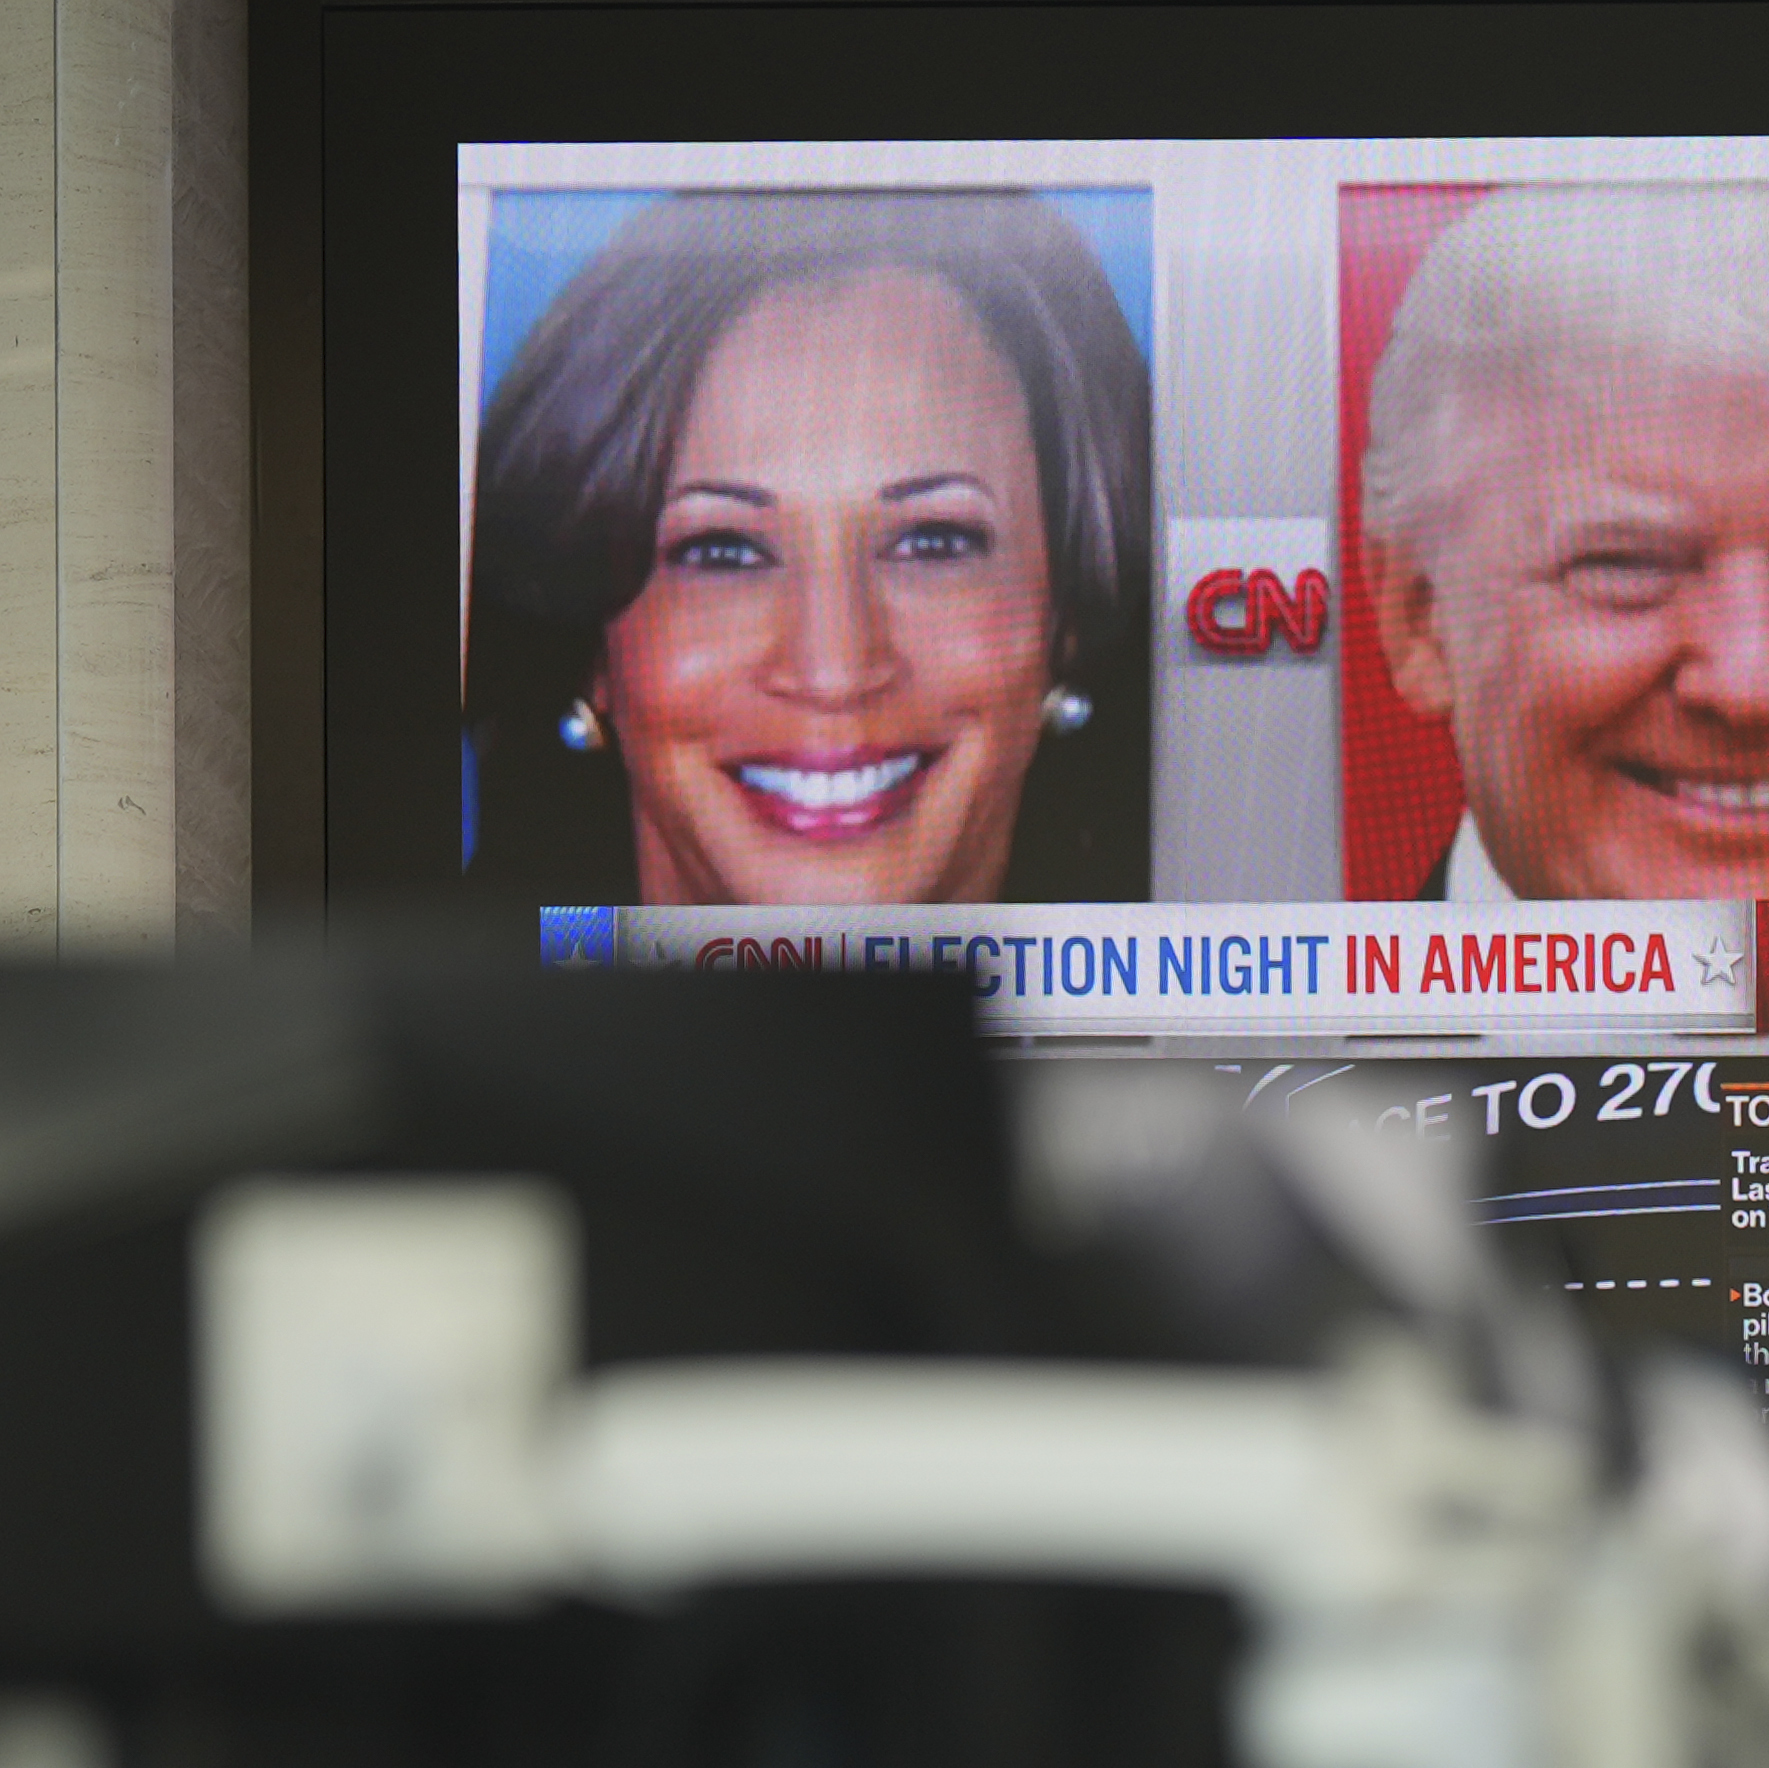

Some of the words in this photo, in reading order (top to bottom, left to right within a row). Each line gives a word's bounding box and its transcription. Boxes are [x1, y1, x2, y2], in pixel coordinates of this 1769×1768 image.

[1159, 935, 1329, 995] NIGHT
[1346, 935, 1399, 994] IN
[1421, 933, 1676, 993] AMERICA
[1471, 1072, 1577, 1135] TO
[1732, 1208, 1765, 1228] on
